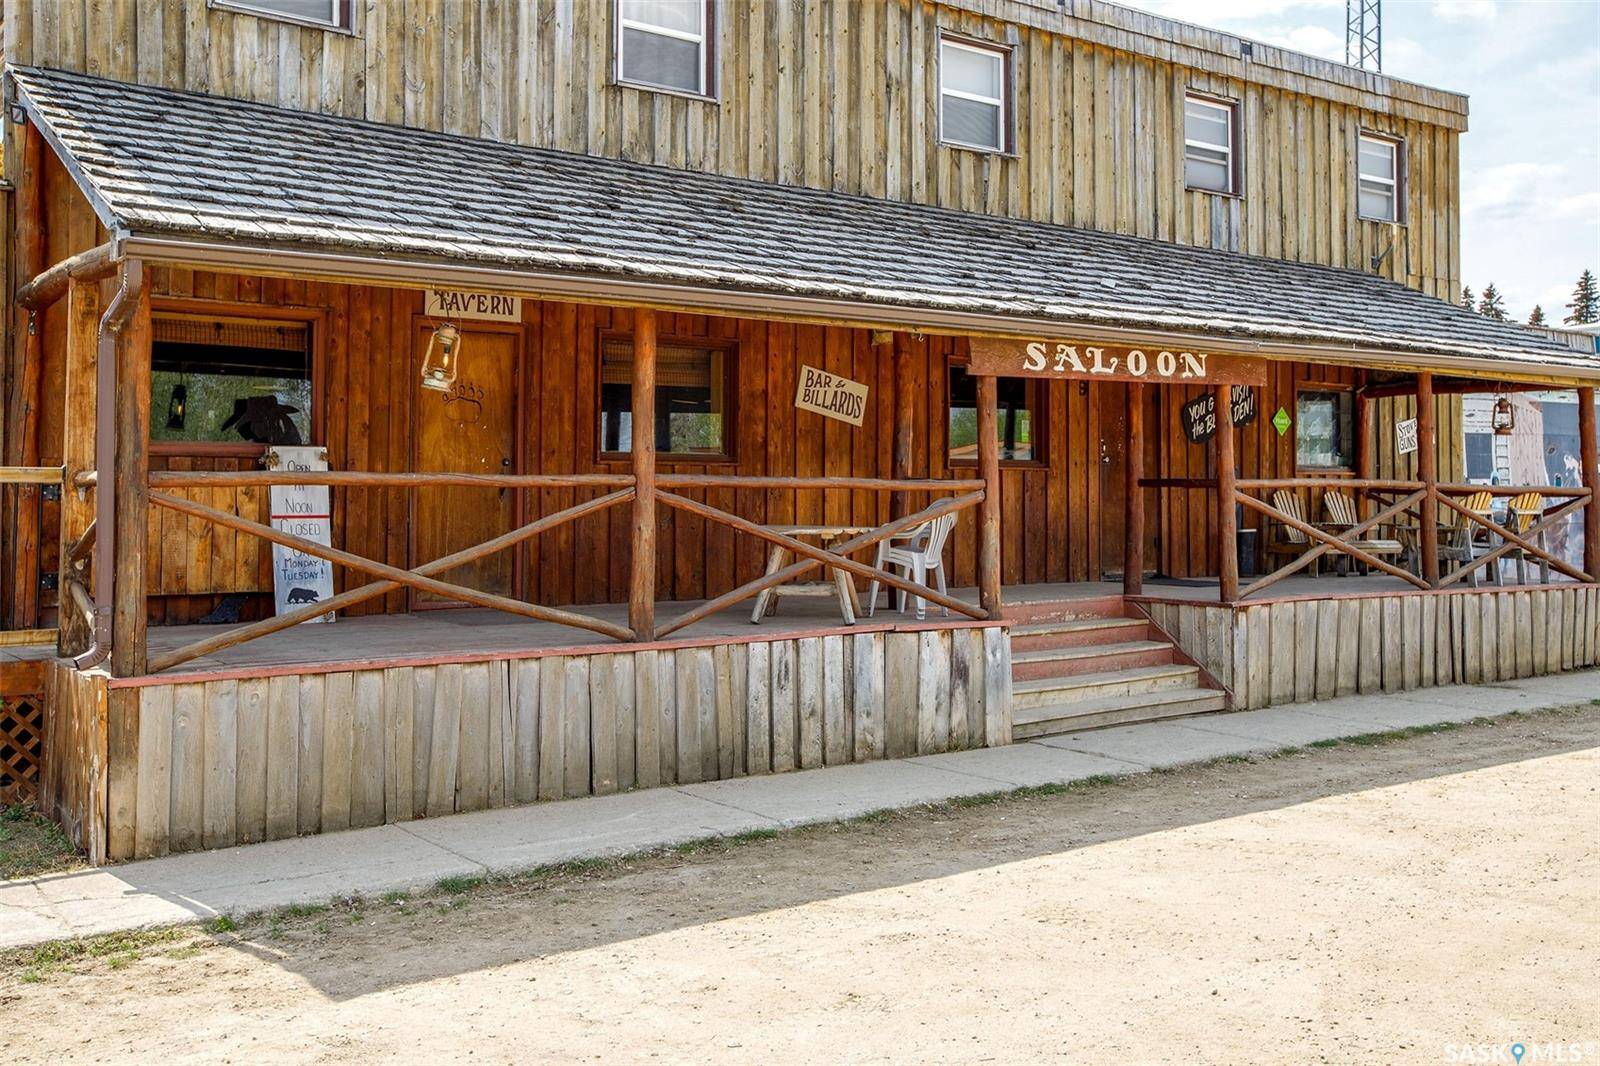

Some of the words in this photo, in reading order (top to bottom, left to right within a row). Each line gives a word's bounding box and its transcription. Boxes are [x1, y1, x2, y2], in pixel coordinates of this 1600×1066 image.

[434, 291, 514, 316] TAVERN
[1023, 342, 1208, 378] SALOON
[805, 370, 832, 388] BAR
[835, 380, 846, 389] &
[802, 389, 863, 418] BILLARDS
[1189, 400, 1206, 422] YOU
[1192, 420, 1204, 439] the
[1233, 394, 1254, 422] DEN!
[1400, 435, 1416, 450] GUNS
